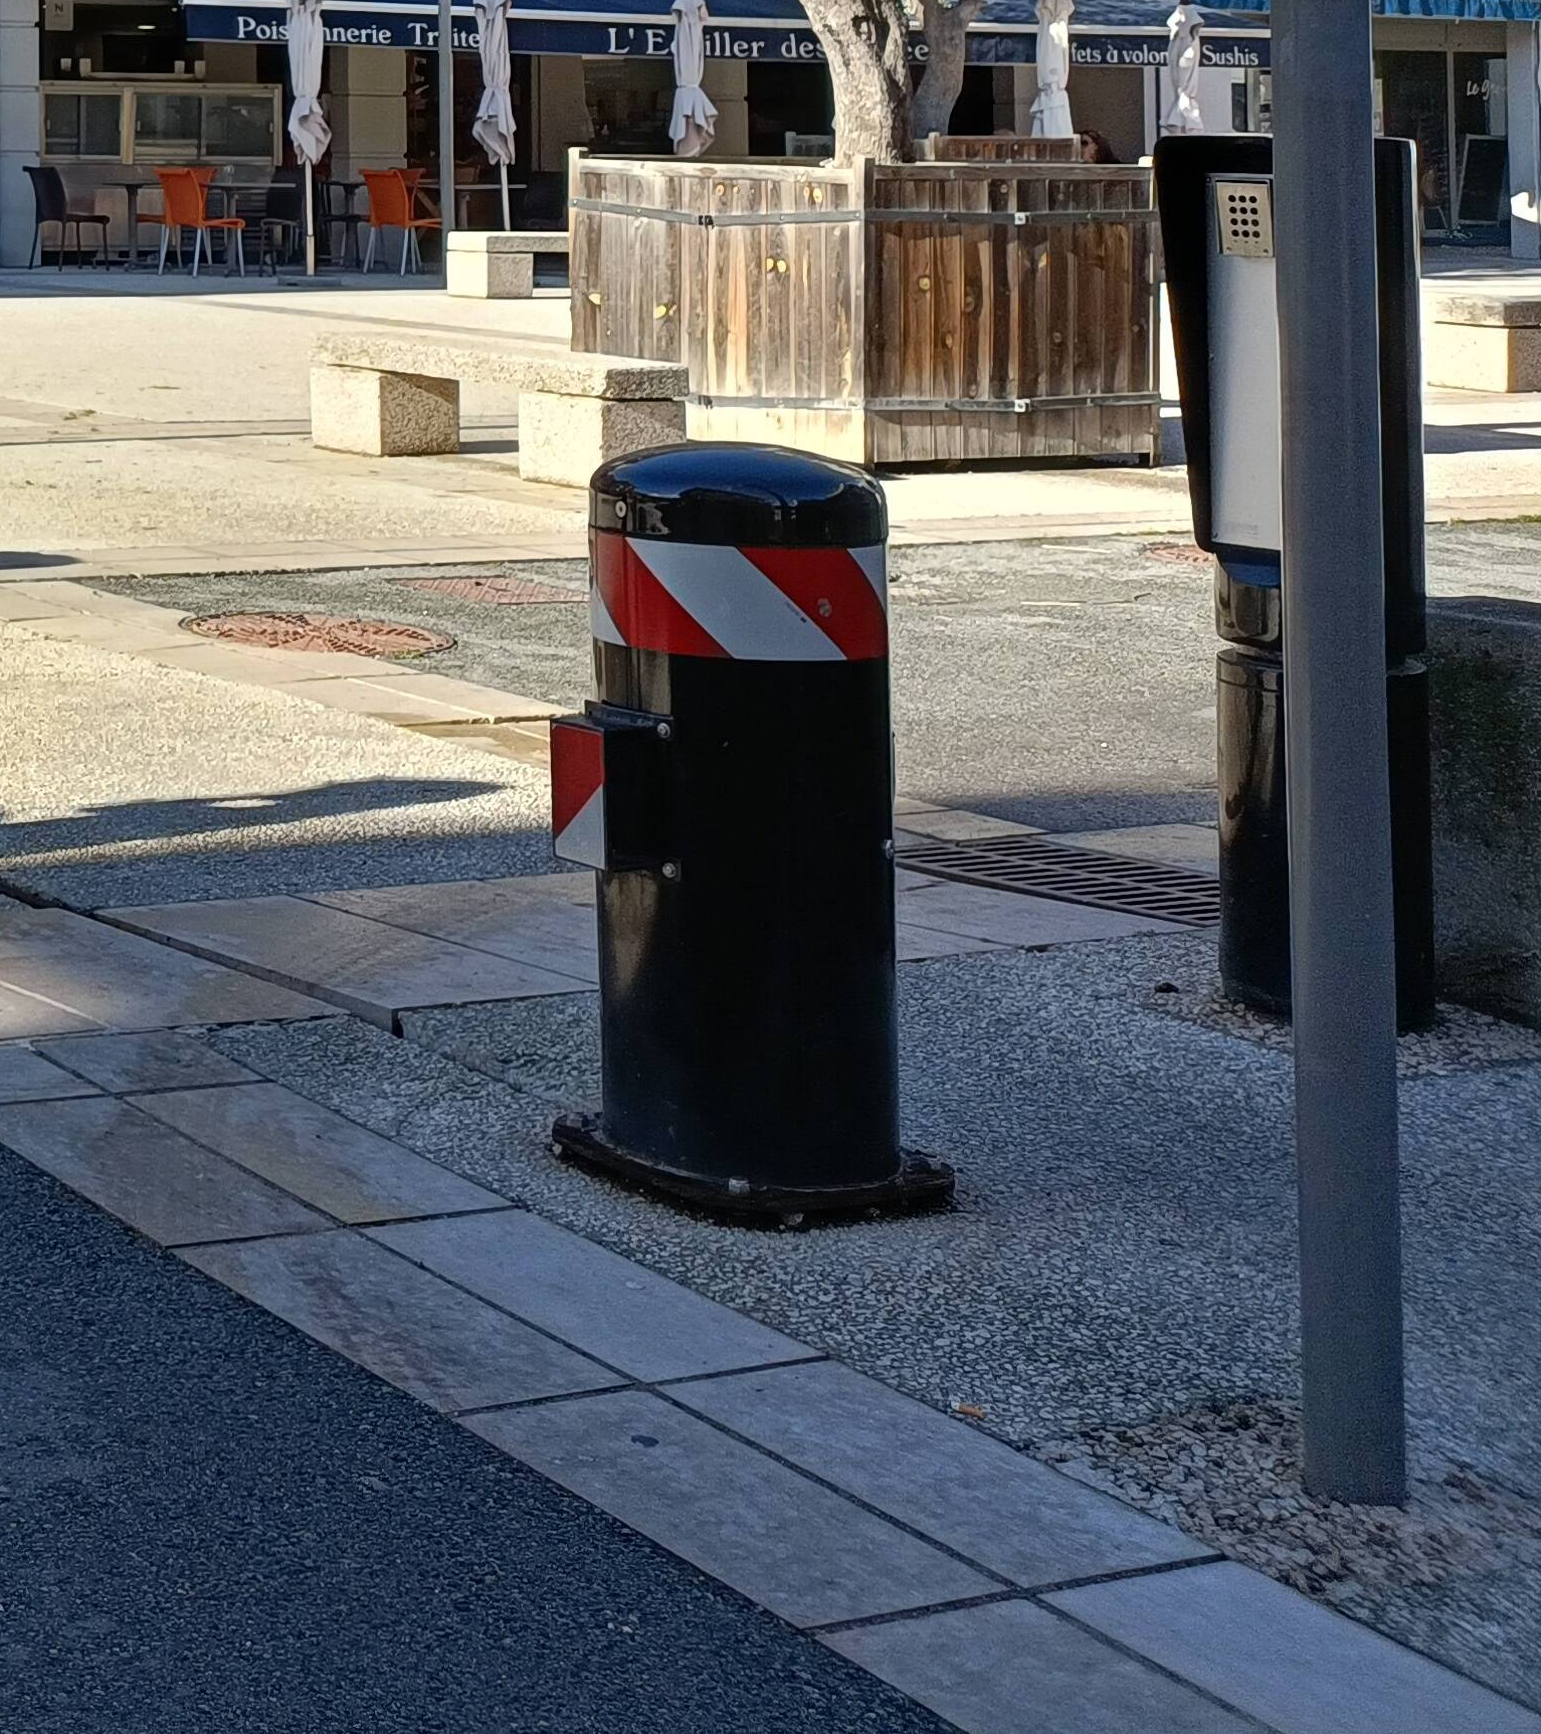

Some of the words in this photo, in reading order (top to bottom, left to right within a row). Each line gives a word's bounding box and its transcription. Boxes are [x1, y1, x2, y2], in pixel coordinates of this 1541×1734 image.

[237, 16, 392, 44] Poisnnerie
[407, 22, 482, 48] Trite
[1106, 44, 1118, 63] à
[1121, 44, 1169, 64] volon
[1202, 44, 1259, 67] Sushis
